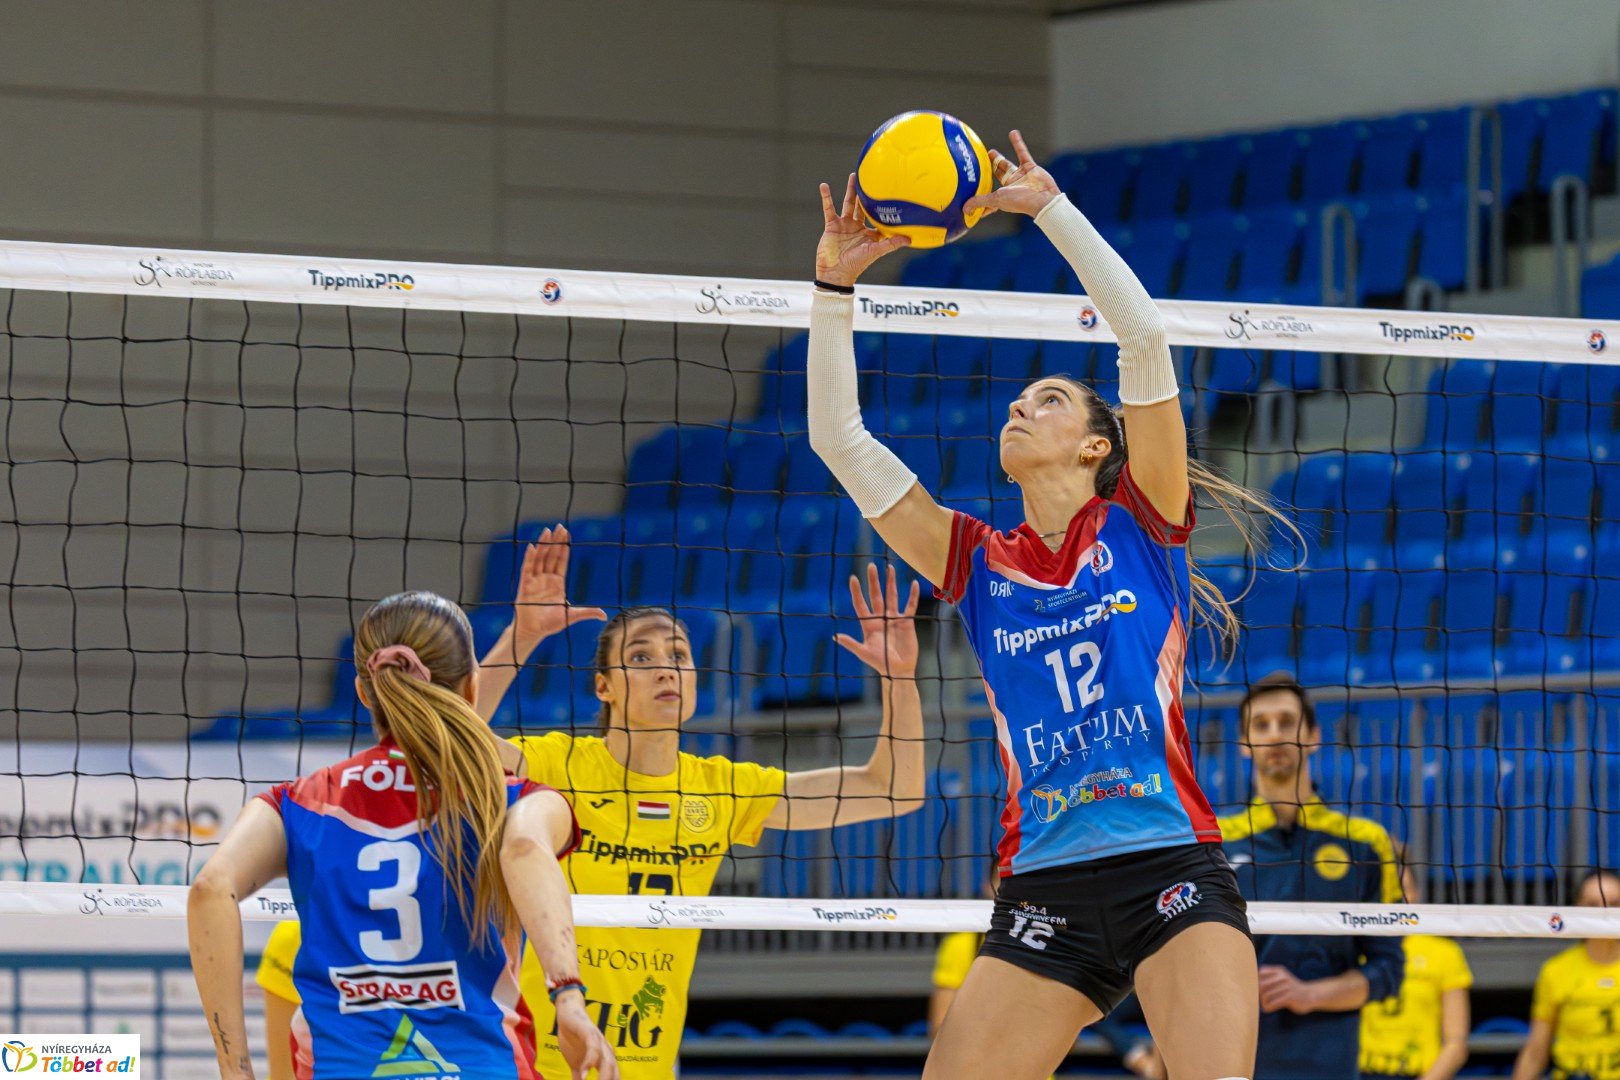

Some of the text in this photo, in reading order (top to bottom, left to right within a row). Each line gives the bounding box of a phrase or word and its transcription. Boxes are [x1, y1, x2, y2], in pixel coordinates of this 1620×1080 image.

[308, 268, 415, 291] TippmixPRO
[859, 297, 959, 319] TippmixPRO
[1379, 321, 1475, 343] TippmixPRO
[993, 589, 1137, 657] TippmixPRO
[1045, 641, 1105, 713] 12
[1130, 772, 1163, 798] ad!
[357, 840, 424, 962] 3
[812, 907, 897, 923] TippmixPRO
[1339, 911, 1419, 928] TippmixPRO
[1009, 915, 1055, 950] 12
